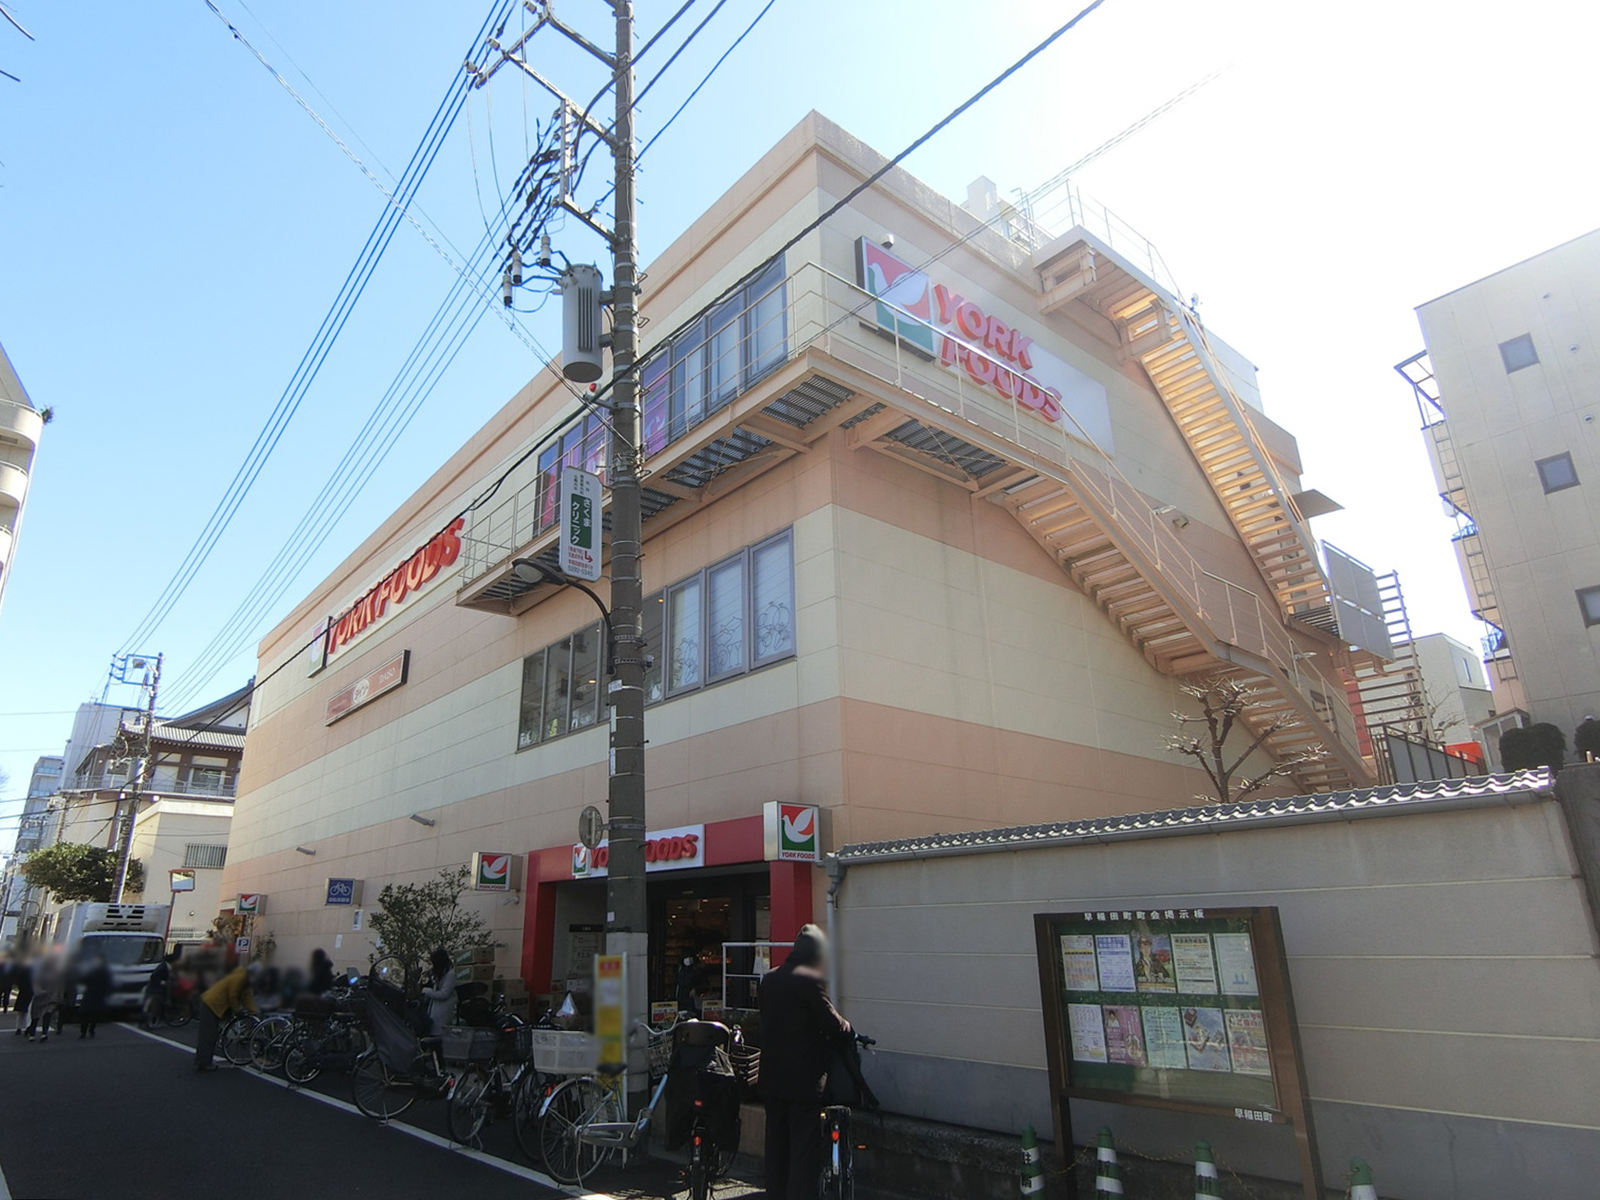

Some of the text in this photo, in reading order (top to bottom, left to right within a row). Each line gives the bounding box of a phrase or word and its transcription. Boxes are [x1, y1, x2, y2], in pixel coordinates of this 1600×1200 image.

[933, 283, 1034, 370] YORK
[941, 332, 1063, 422] FOODS
[571, 501, 581, 545] クリニック
[376, 518, 466, 618] FOODS
[645, 833, 699, 863] OODS
[797, 852, 816, 860] FOODS
[1234, 1108, 1273, 1123] 早稲田町
